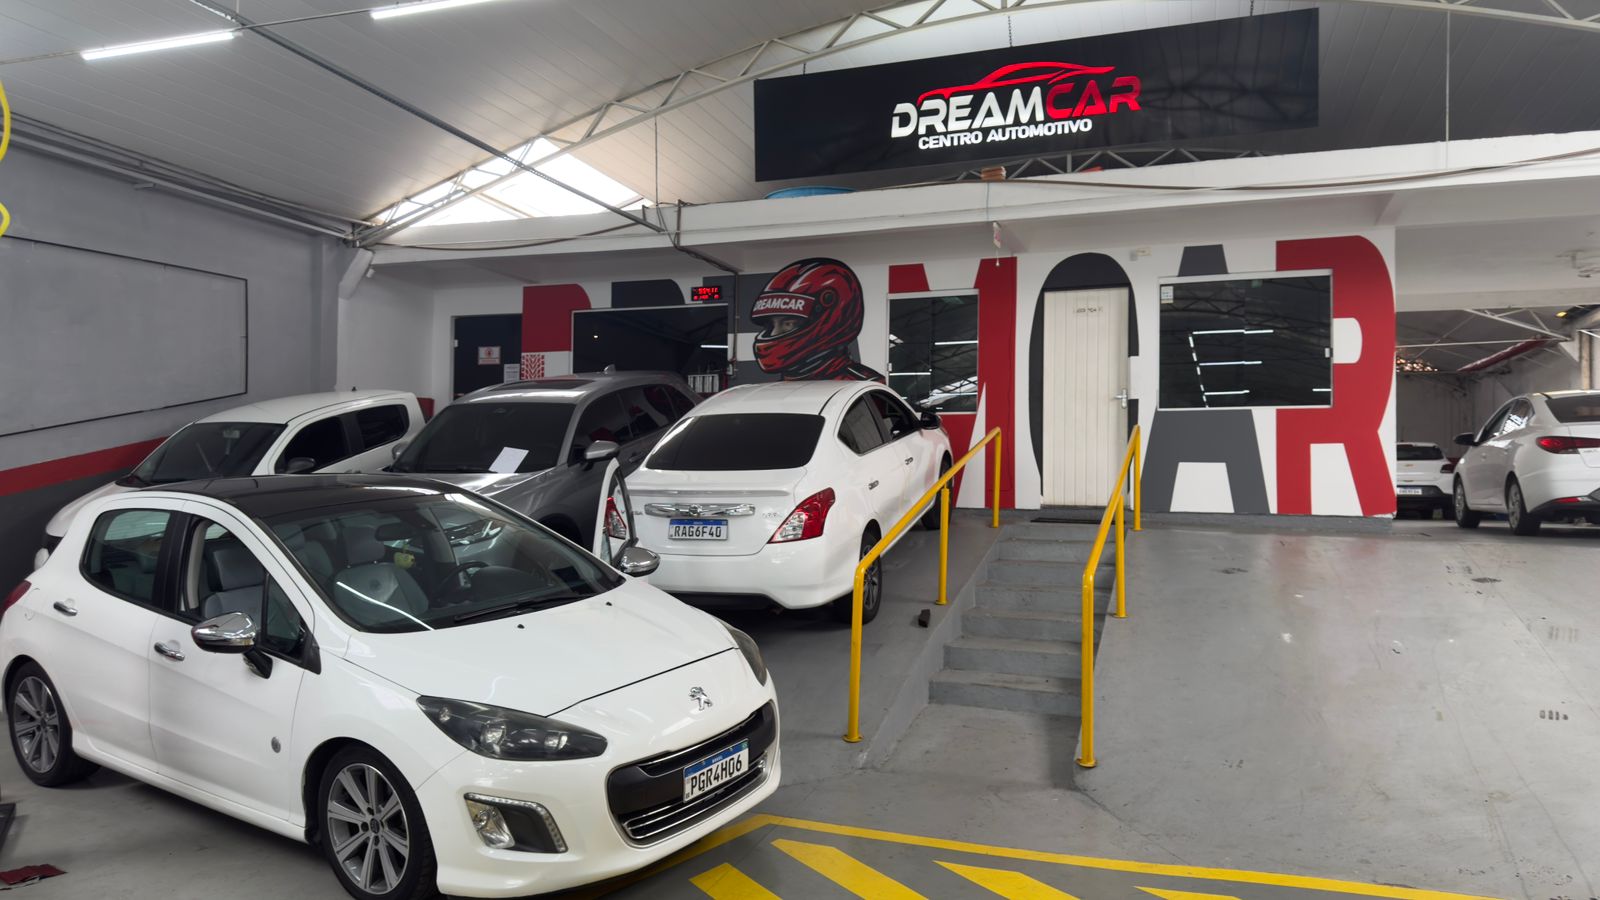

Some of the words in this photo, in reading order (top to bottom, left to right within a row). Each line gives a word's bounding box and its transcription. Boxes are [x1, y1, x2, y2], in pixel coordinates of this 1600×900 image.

[891, 75, 1142, 138] DREAMCAR
[918, 130, 983, 150] CENTRO
[986, 118, 1093, 143] AUTOMOTIVO
[673, 525, 722, 538] RAG6F40
[690, 754, 743, 795] PGR4H06
